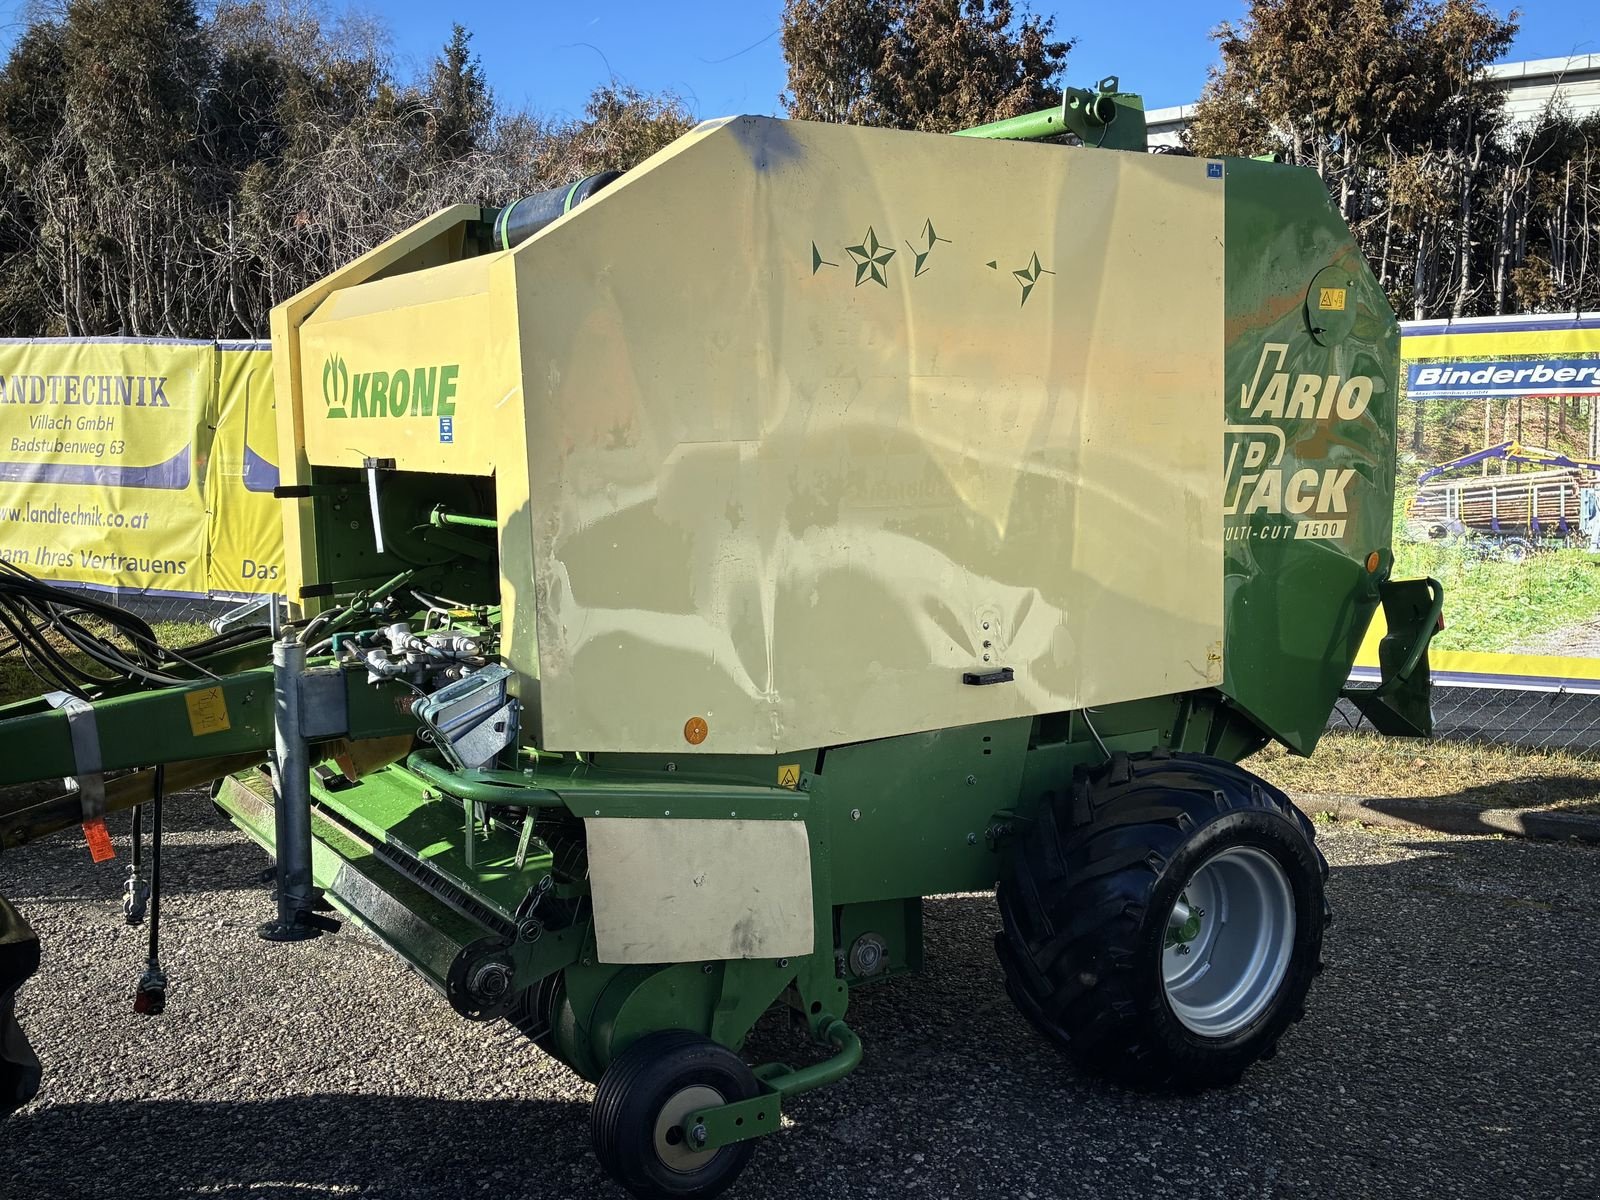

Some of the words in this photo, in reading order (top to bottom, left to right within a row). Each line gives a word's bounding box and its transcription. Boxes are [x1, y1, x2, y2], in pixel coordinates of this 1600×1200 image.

[351, 364, 459, 418] KRONE
[29, 415, 72, 431] Villach
[76, 416, 115, 432] GmbH
[11, 437, 105, 458] Badstubenweg
[110, 440, 126, 455] 63
[1223, 525, 1291, 541] ULTI-CUT
[1303, 522, 1339, 538] 1500
[0, 547, 29, 564] am
[35, 546, 74, 568] Ihres
[80, 549, 187, 575] Vertrauens
[241, 559, 279, 580] Das
